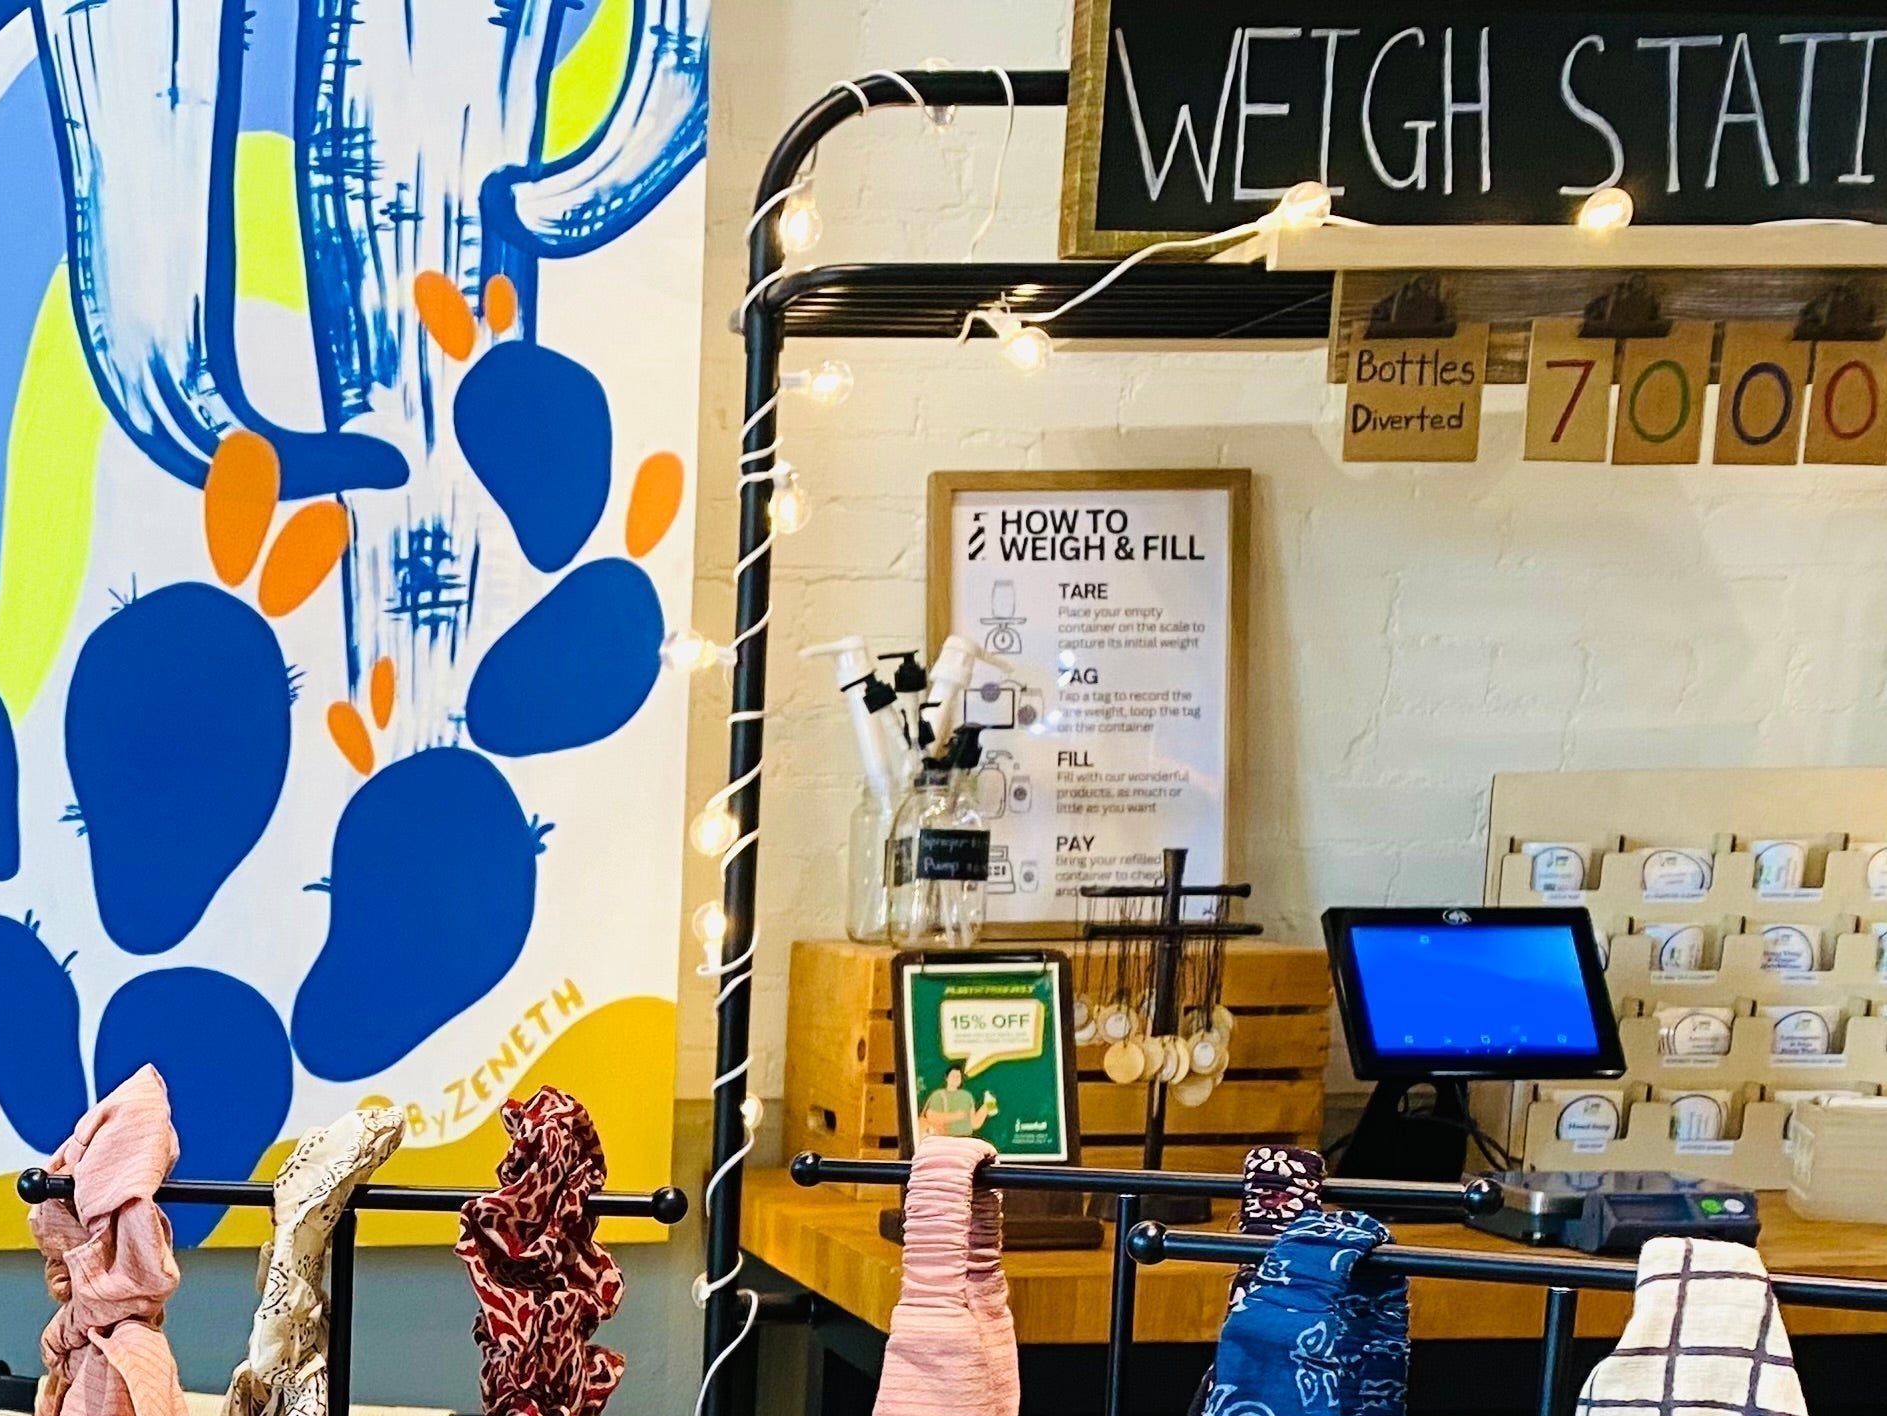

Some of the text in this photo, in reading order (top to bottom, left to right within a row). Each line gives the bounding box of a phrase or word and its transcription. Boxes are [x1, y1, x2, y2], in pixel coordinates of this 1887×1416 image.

[1115, 26, 1491, 204] WEIGH
[1355, 348, 1476, 389] Bottles
[1351, 402, 1465, 435] Diverted
[1001, 509, 1128, 535] HOW TO
[1000, 535, 1205, 562] WEIGH & FILL
[1058, 583, 1108, 600] TARE
[1058, 606, 1163, 620] Place your empty
[1058, 622, 1205, 633] container on the scale to
[1058, 638, 1105, 650] capture
[1124, 637, 1156, 649] initial
[1160, 637, 1199, 650] weight
[1092, 691, 1111, 704] tag
[1114, 691, 1127, 702] to
[1129, 690, 1169, 702] record
[1172, 690, 1192, 702] the
[1159, 706, 1180, 718] the
[1182, 706, 1201, 720] tag
[1098, 722, 1154, 733] container
[1058, 750, 1094, 767] FILL
[1057, 771, 1189, 783] Fill with our wonderful
[1133, 787, 1167, 798] much
[1101, 804, 1125, 816] you
[1127, 803, 1156, 814] want
[1056, 836, 1095, 851] PAY
[1089, 856, 1117, 867] your
[1056, 871, 1111, 881] container
[1115, 871, 1128, 881] to
[951, 1013, 1030, 1030] 15% OFF
